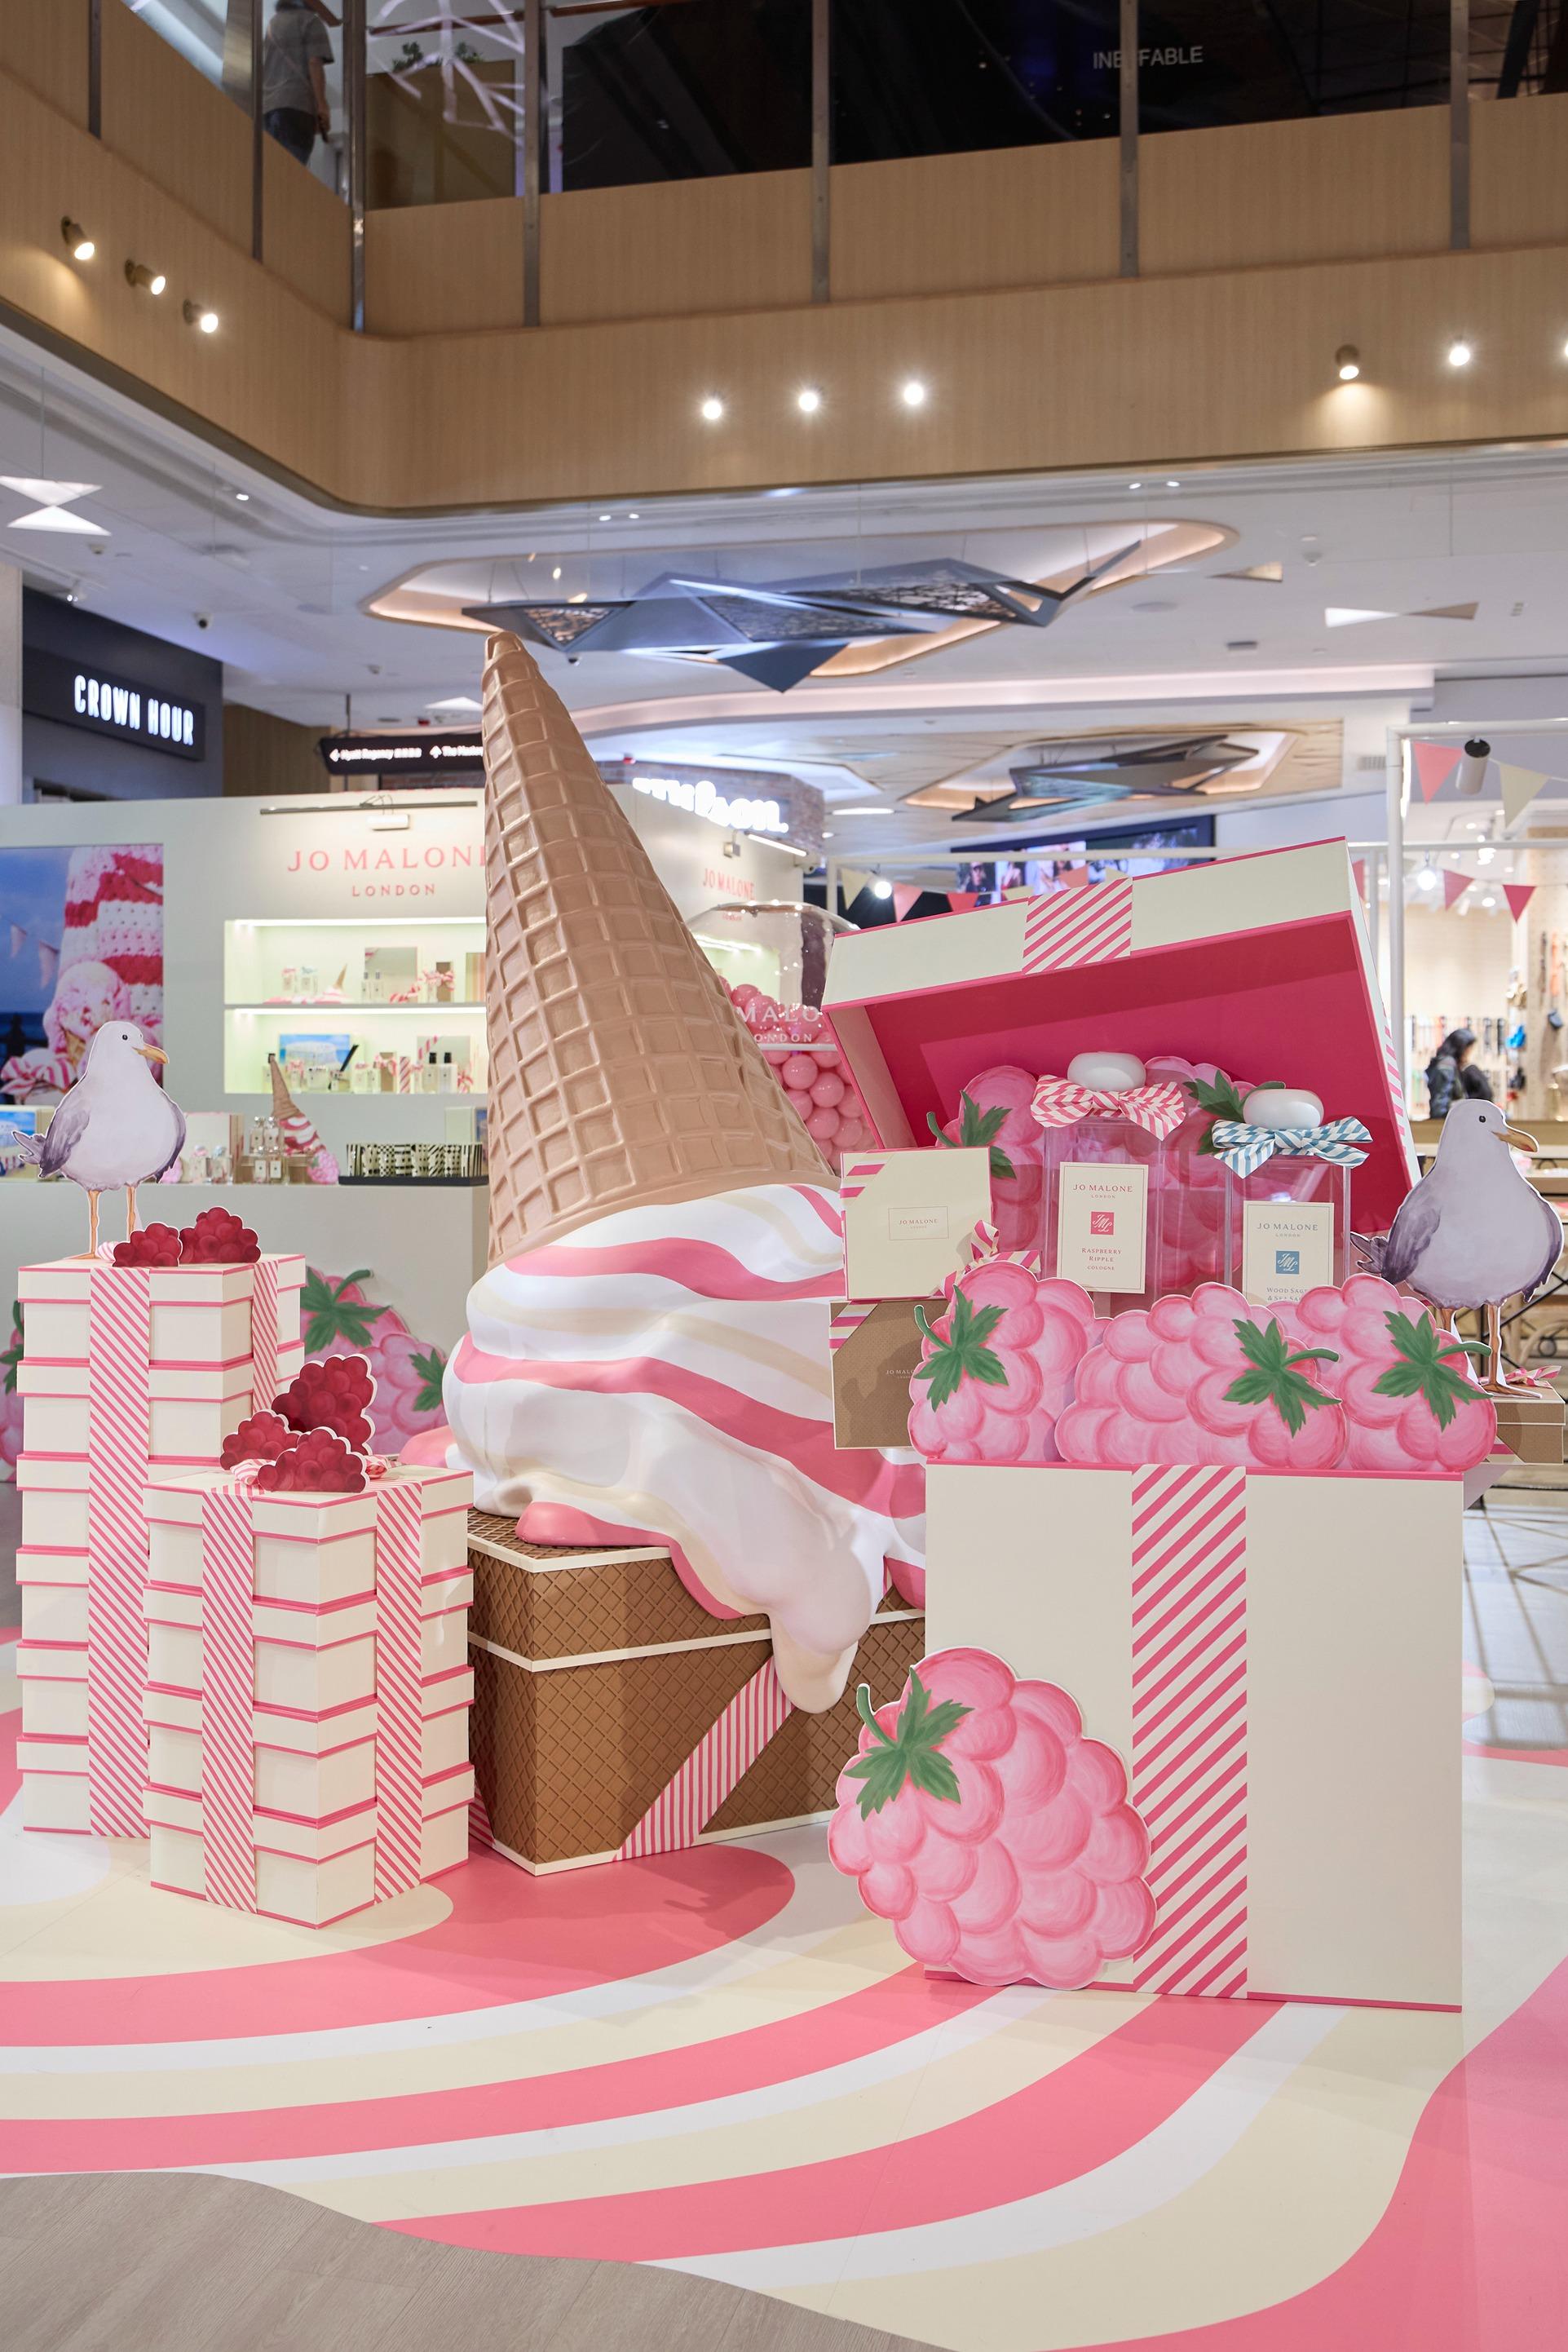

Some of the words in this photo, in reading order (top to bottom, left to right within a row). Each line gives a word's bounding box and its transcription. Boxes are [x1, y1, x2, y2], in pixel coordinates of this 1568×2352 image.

[1093, 46, 1204, 69] INEFABLE
[74, 674, 141, 730] CROWN
[148, 698, 194, 746] HOUR
[287, 850, 329, 872] JO
[351, 884, 435, 897] LONDON
[703, 868, 715, 888] JO
[718, 872, 756, 900] MALONE
[735, 1006, 820, 1023] MALO
[753, 1033, 813, 1042] ONDON
